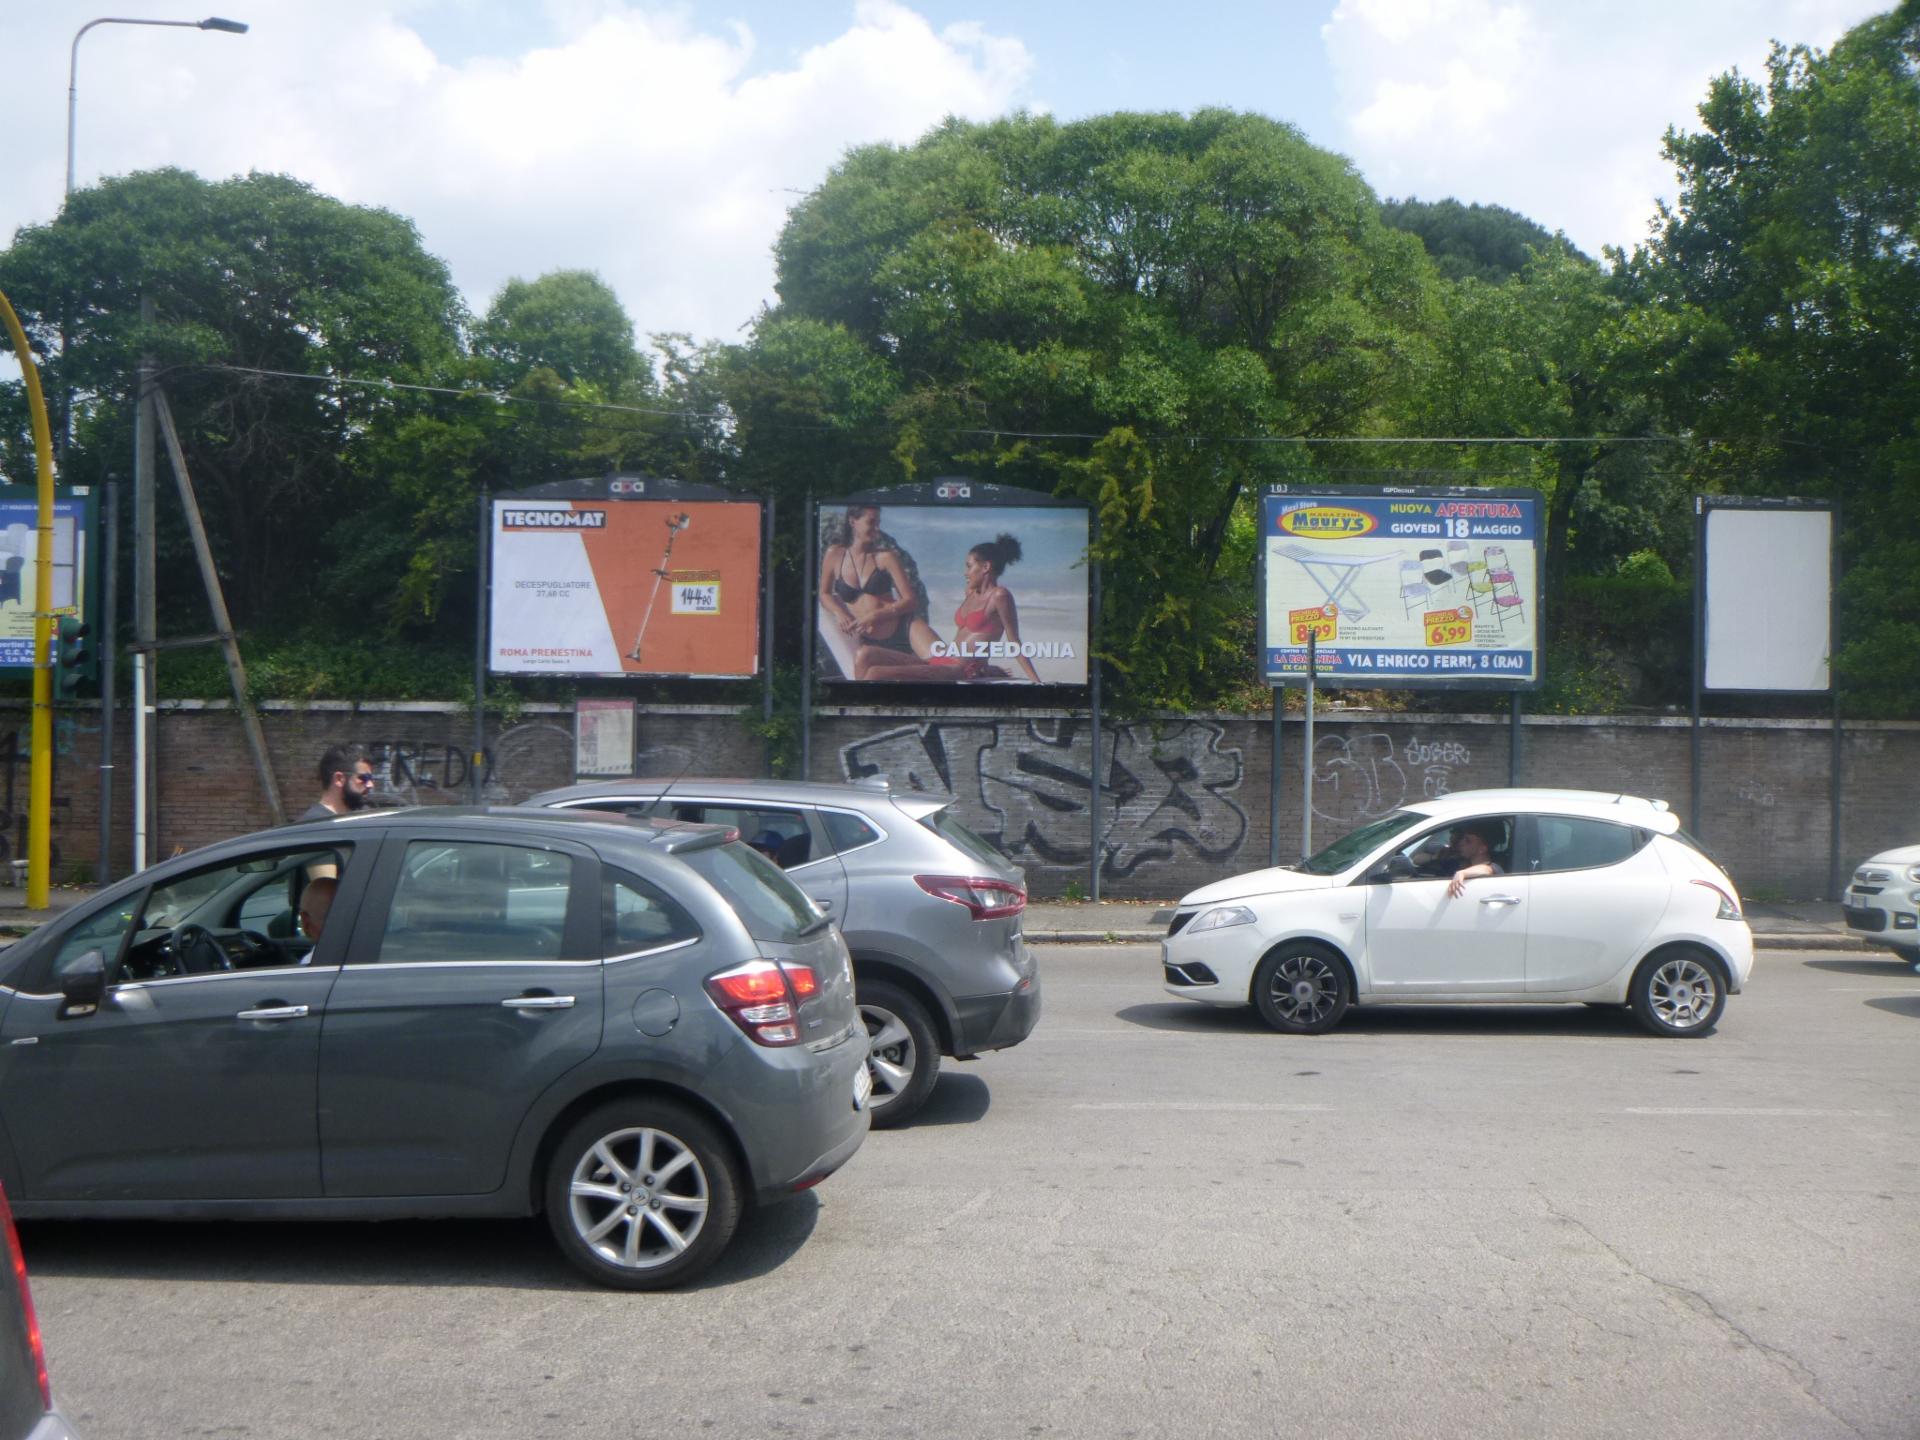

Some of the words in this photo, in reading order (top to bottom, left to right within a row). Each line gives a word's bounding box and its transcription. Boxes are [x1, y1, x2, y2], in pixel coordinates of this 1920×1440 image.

[1390, 503, 1432, 514] NUOVA
[1435, 503, 1522, 518] APERTURA
[505, 512, 604, 526] TECNOMAT
[1292, 512, 1364, 531] Maury's
[1391, 523, 1440, 533] GIOVEDI
[1445, 519, 1469, 538] 18
[1472, 525, 1522, 535] MAGGIO
[515, 581, 592, 589] DECESPUGLIATORE
[499, 648, 528, 657] ROMA
[531, 648, 593, 657] PRENESTINA
[930, 641, 1075, 659] CALZEDONIA
[1347, 653, 1372, 667] VIA
[1377, 653, 1429, 668] ENRICO
[1434, 654, 1477, 669] FERRI,
[1480, 655, 1489, 667] 8
[1493, 655, 1524, 669] (RM)
